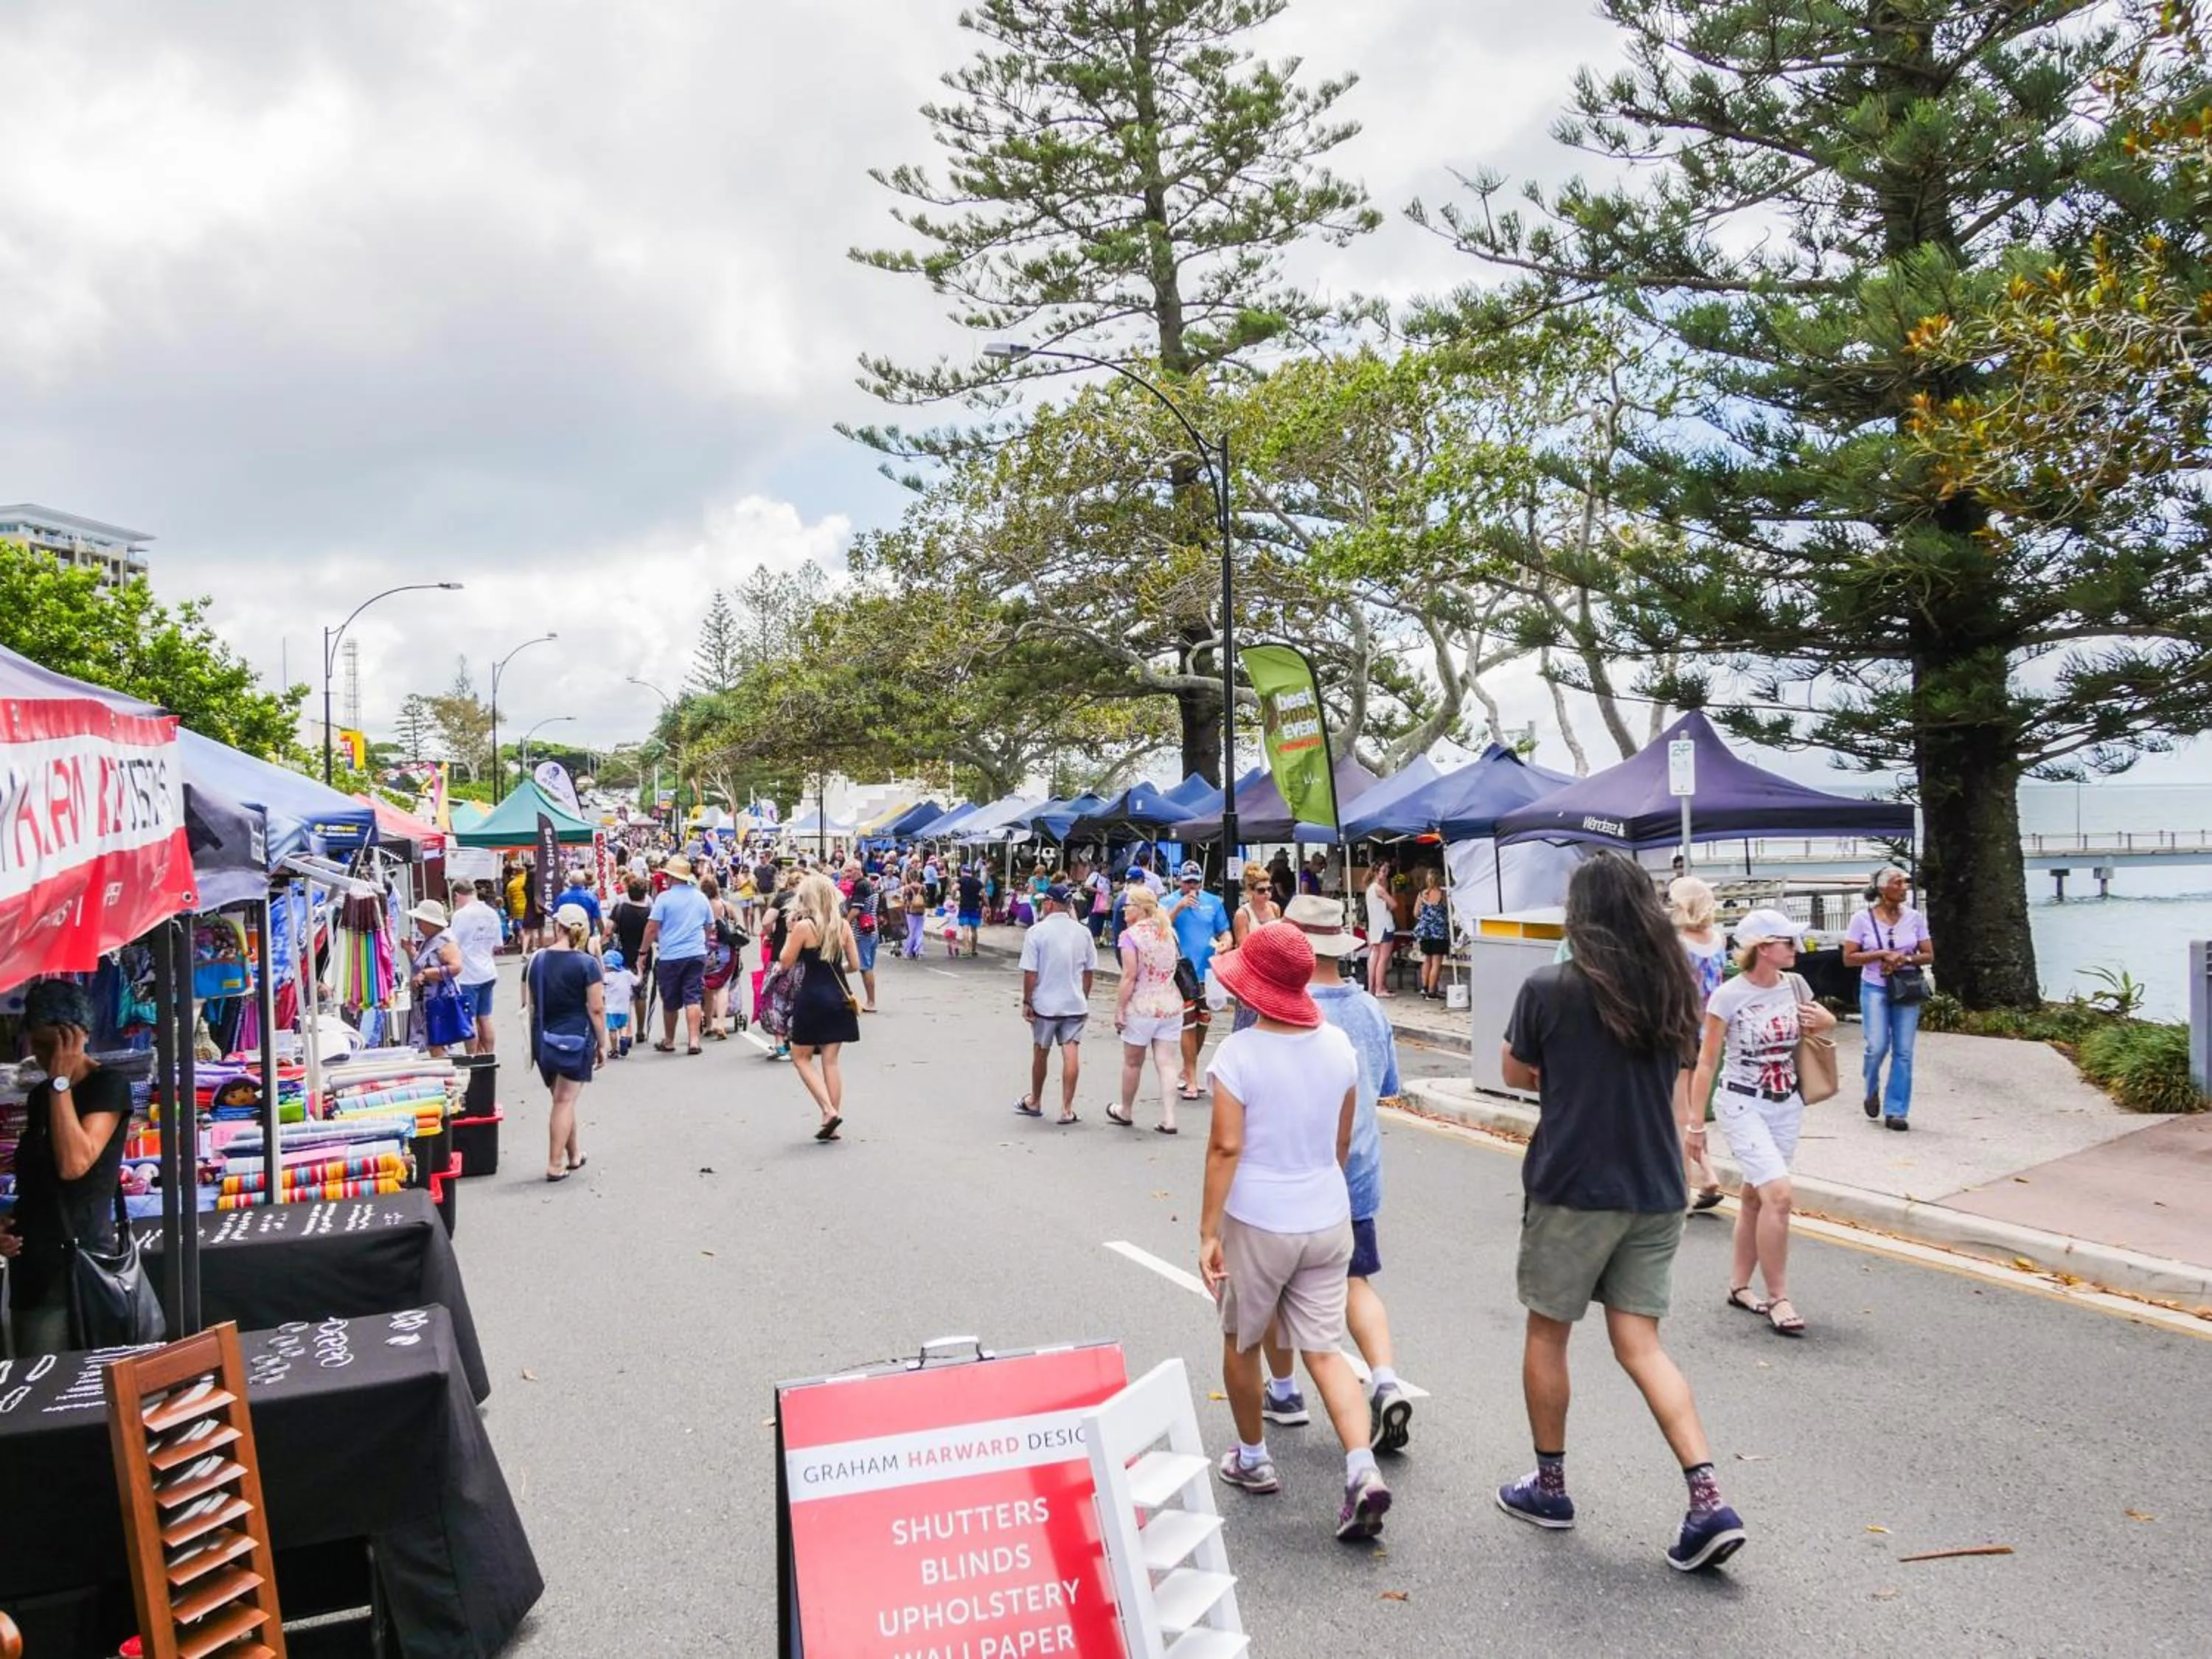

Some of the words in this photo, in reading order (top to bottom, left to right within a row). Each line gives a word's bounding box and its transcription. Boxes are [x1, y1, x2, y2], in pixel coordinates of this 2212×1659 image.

[1276, 686, 1315, 712] best
[544, 827, 554, 866] CHIPS
[546, 870, 554, 880] &
[803, 1454, 899, 1484] GRAHAM
[908, 1436, 1019, 1468] HARWARD
[1028, 1426, 1086, 1450] DESIG
[891, 1497, 1050, 1545] SHUTTERS
[921, 1543, 1032, 1585] BLINDS
[878, 1578, 1081, 1637] UPHOLSTERY
